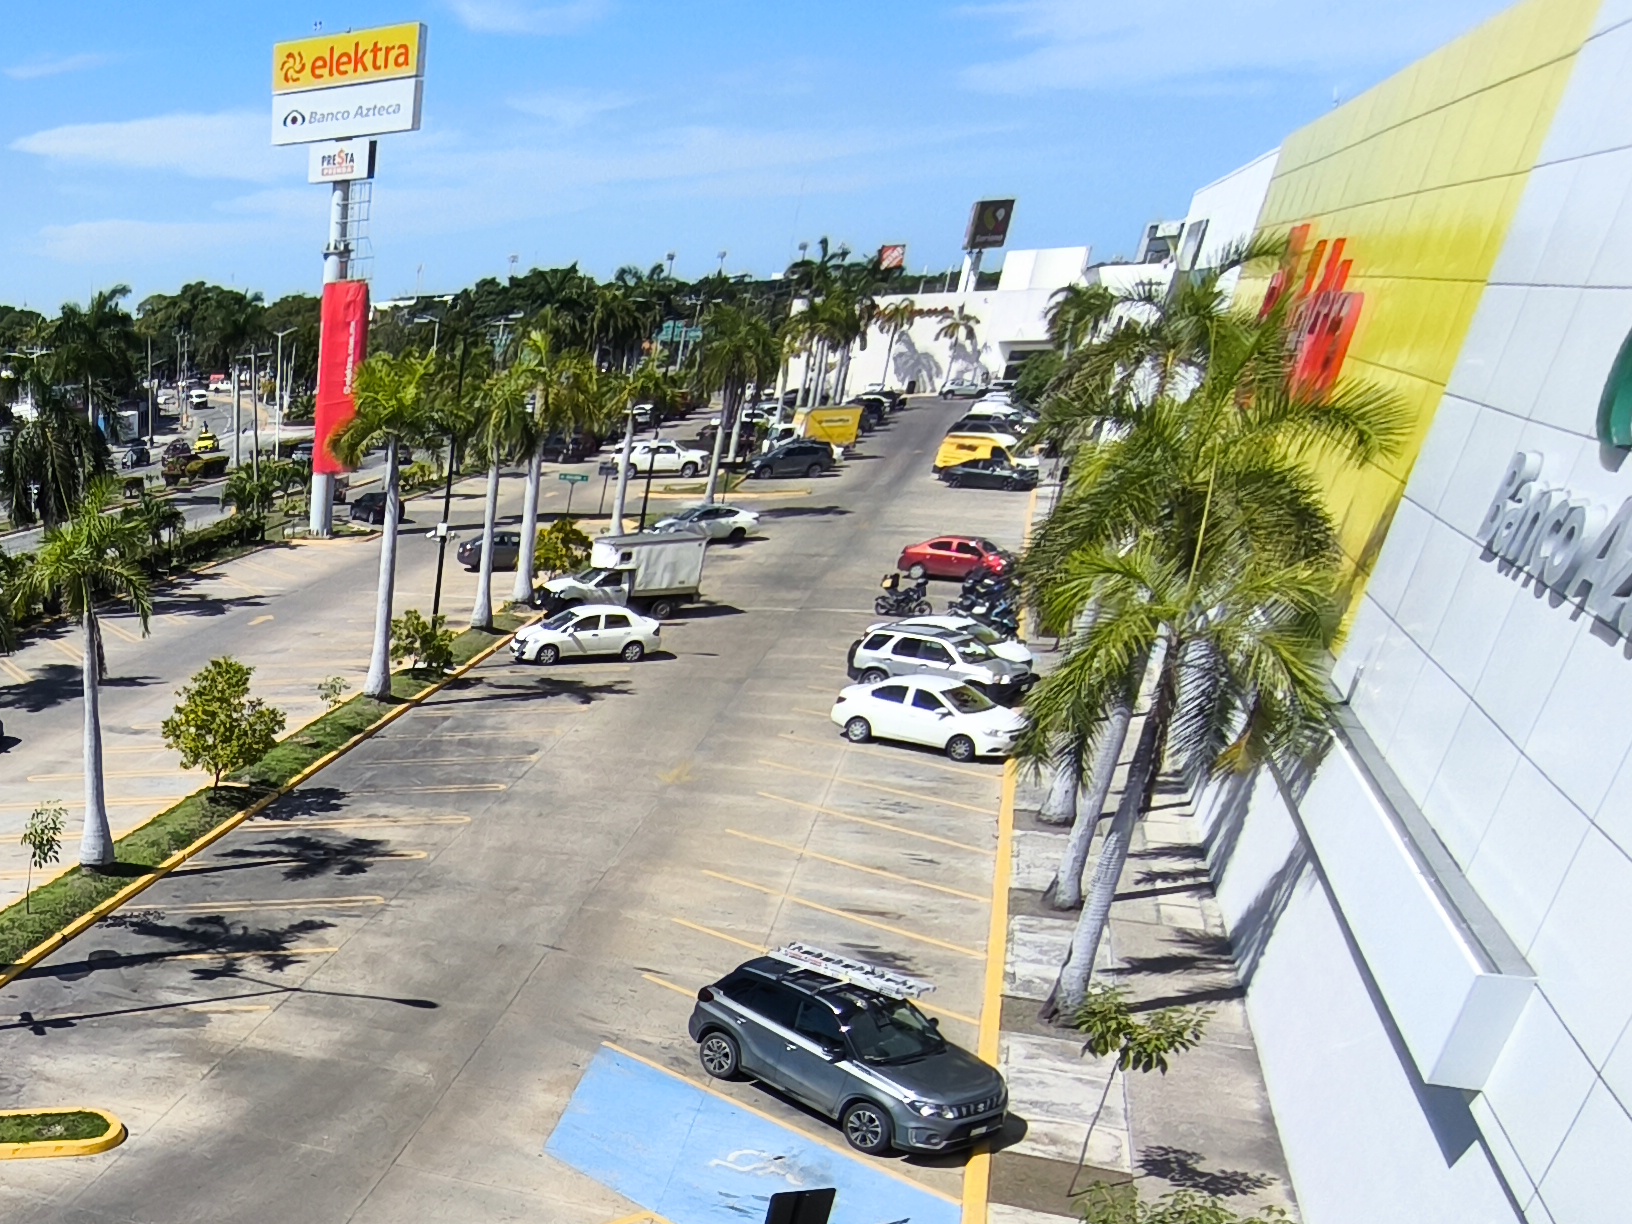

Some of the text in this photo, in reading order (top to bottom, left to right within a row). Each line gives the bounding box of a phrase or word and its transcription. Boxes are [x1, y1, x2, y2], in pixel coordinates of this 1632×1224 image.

[310, 41, 409, 79] elektra
[308, 102, 401, 125] Banco Azteca
[1476, 451, 1587, 586] Banco
